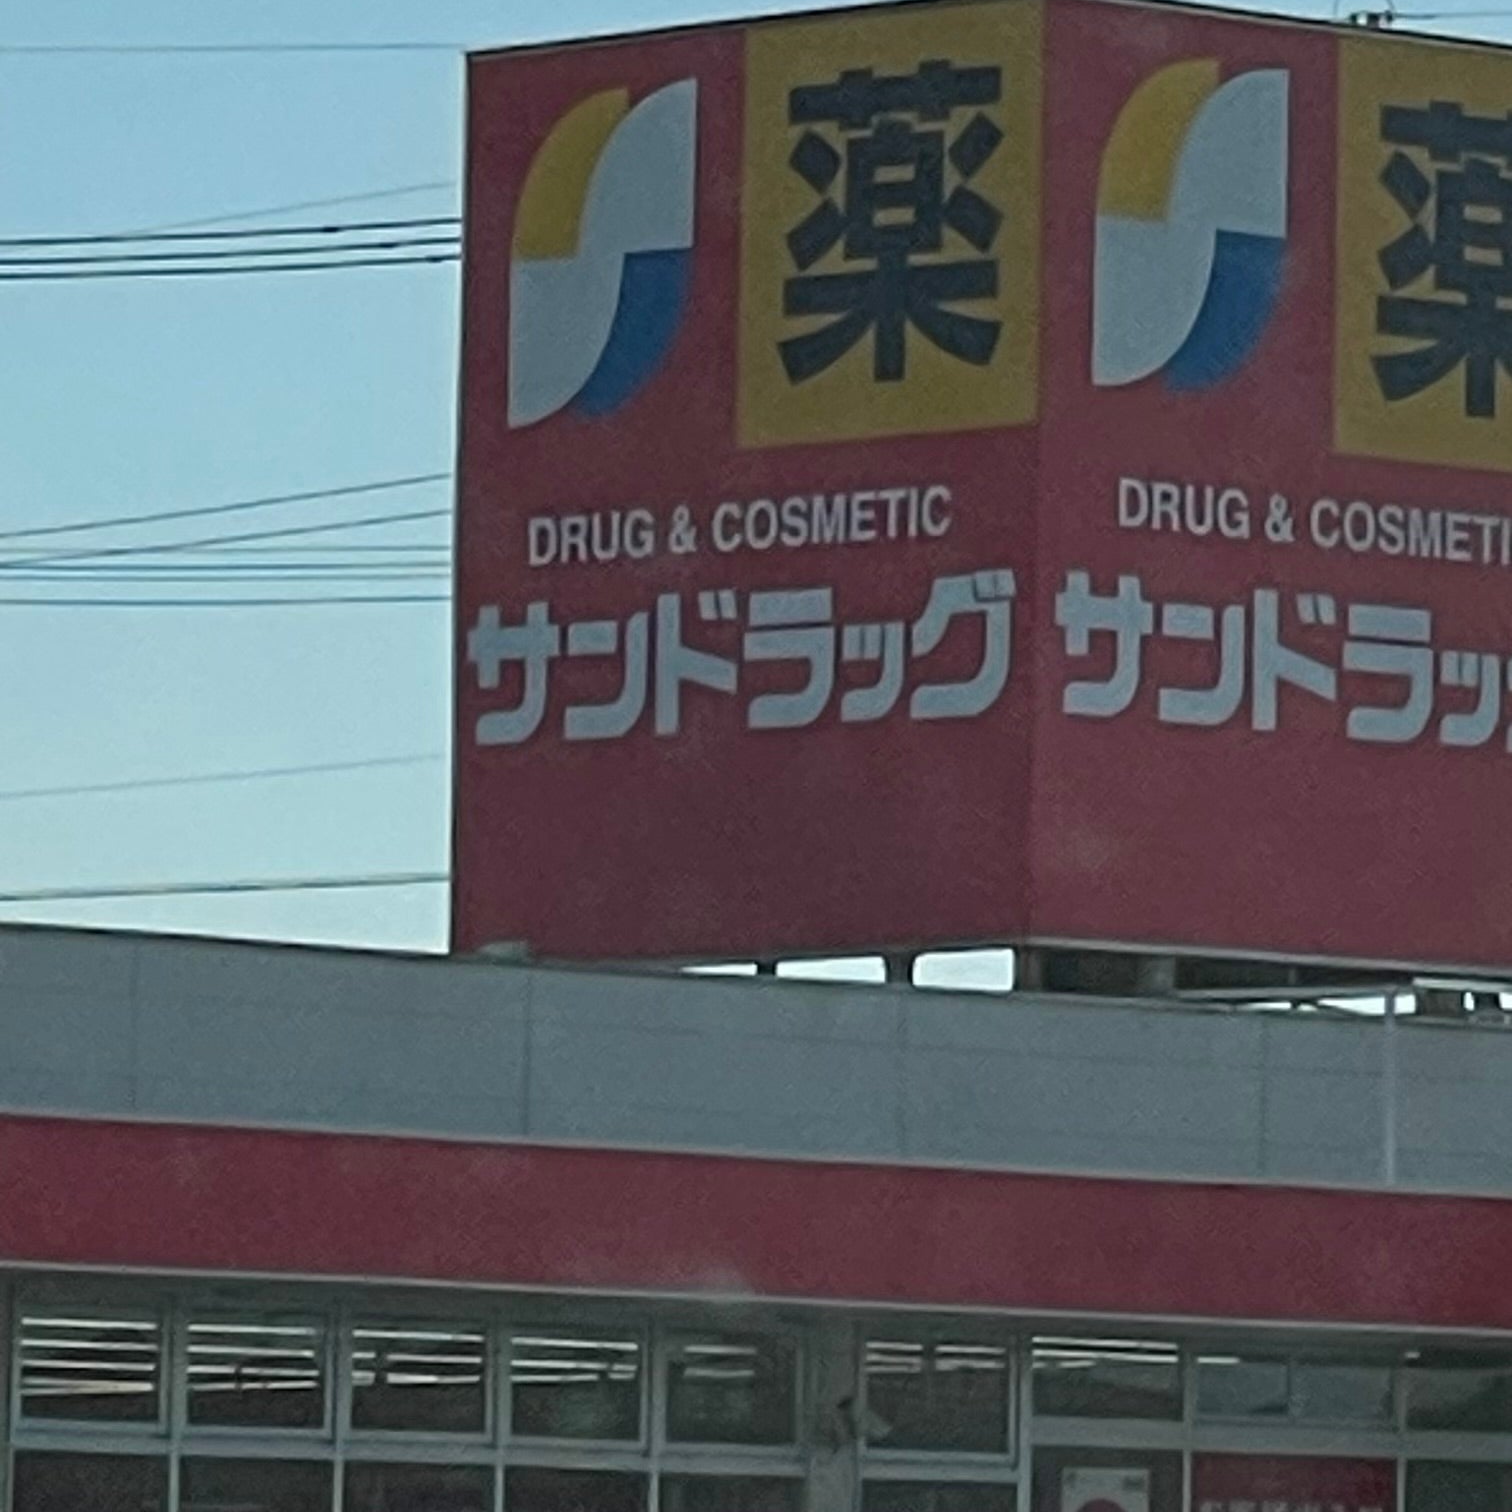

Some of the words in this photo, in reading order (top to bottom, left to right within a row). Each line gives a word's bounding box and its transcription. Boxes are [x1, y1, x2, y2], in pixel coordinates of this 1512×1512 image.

[778, 59, 1003, 384] 薬
[528, 510, 654, 566] DRUG
[669, 505, 697, 554] &
[713, 486, 952, 553] COSMETIC
[1119, 478, 1250, 540] DRUG
[1264, 494, 1294, 544] &
[467, 568, 1016, 746] サンドラッグ
